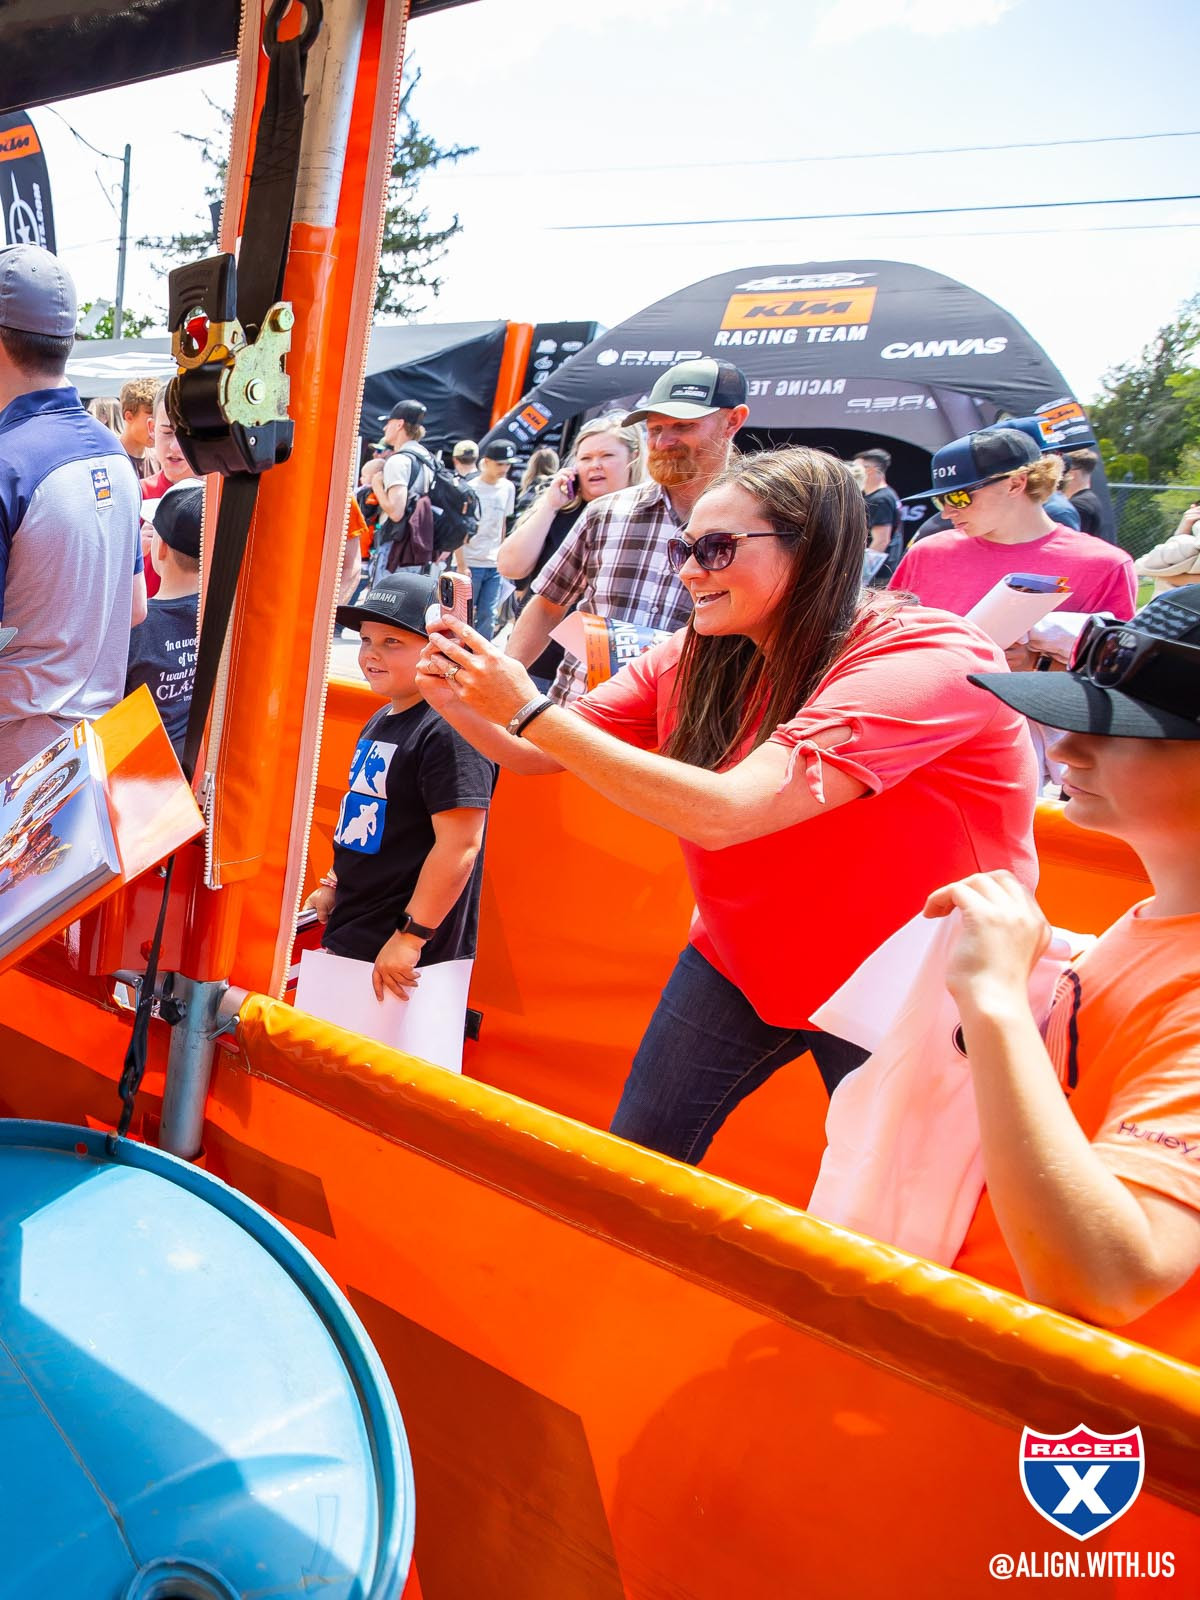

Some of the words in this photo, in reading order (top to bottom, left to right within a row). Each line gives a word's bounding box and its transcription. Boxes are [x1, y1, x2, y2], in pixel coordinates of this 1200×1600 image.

[744, 300, 853, 318] KTM
[714, 329, 798, 346] RACING
[806, 325, 869, 343] TEAM
[621, 350, 703, 361] REP
[880, 337, 1008, 359] CANVAS
[933, 464, 957, 479] FOX
[165, 640, 175, 652] In
[175, 641, 181, 649] a
[178, 652, 187, 667] of
[160, 672, 166, 682] I
[166, 669, 188, 681] want
[1117, 1121, 1198, 1154] Hurley
